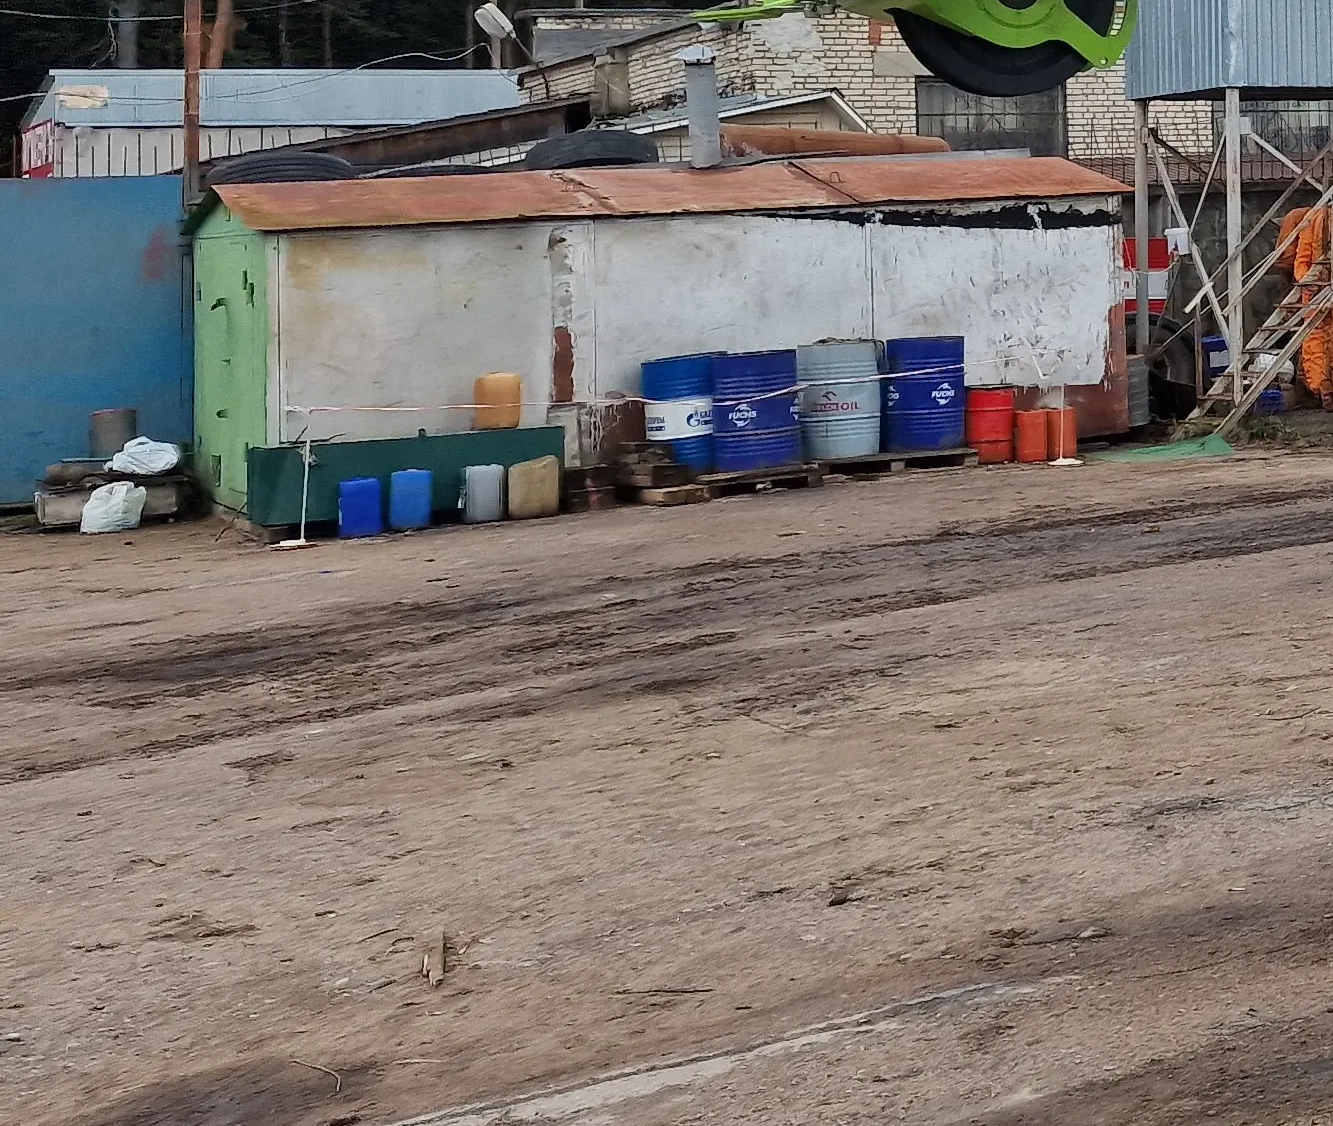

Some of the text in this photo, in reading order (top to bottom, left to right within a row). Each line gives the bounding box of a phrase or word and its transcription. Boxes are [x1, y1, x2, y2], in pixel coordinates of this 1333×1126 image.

[930, 389, 955, 399] FUCHS
[840, 402, 860, 411] OIL
[728, 410, 758, 421] FUCHS
